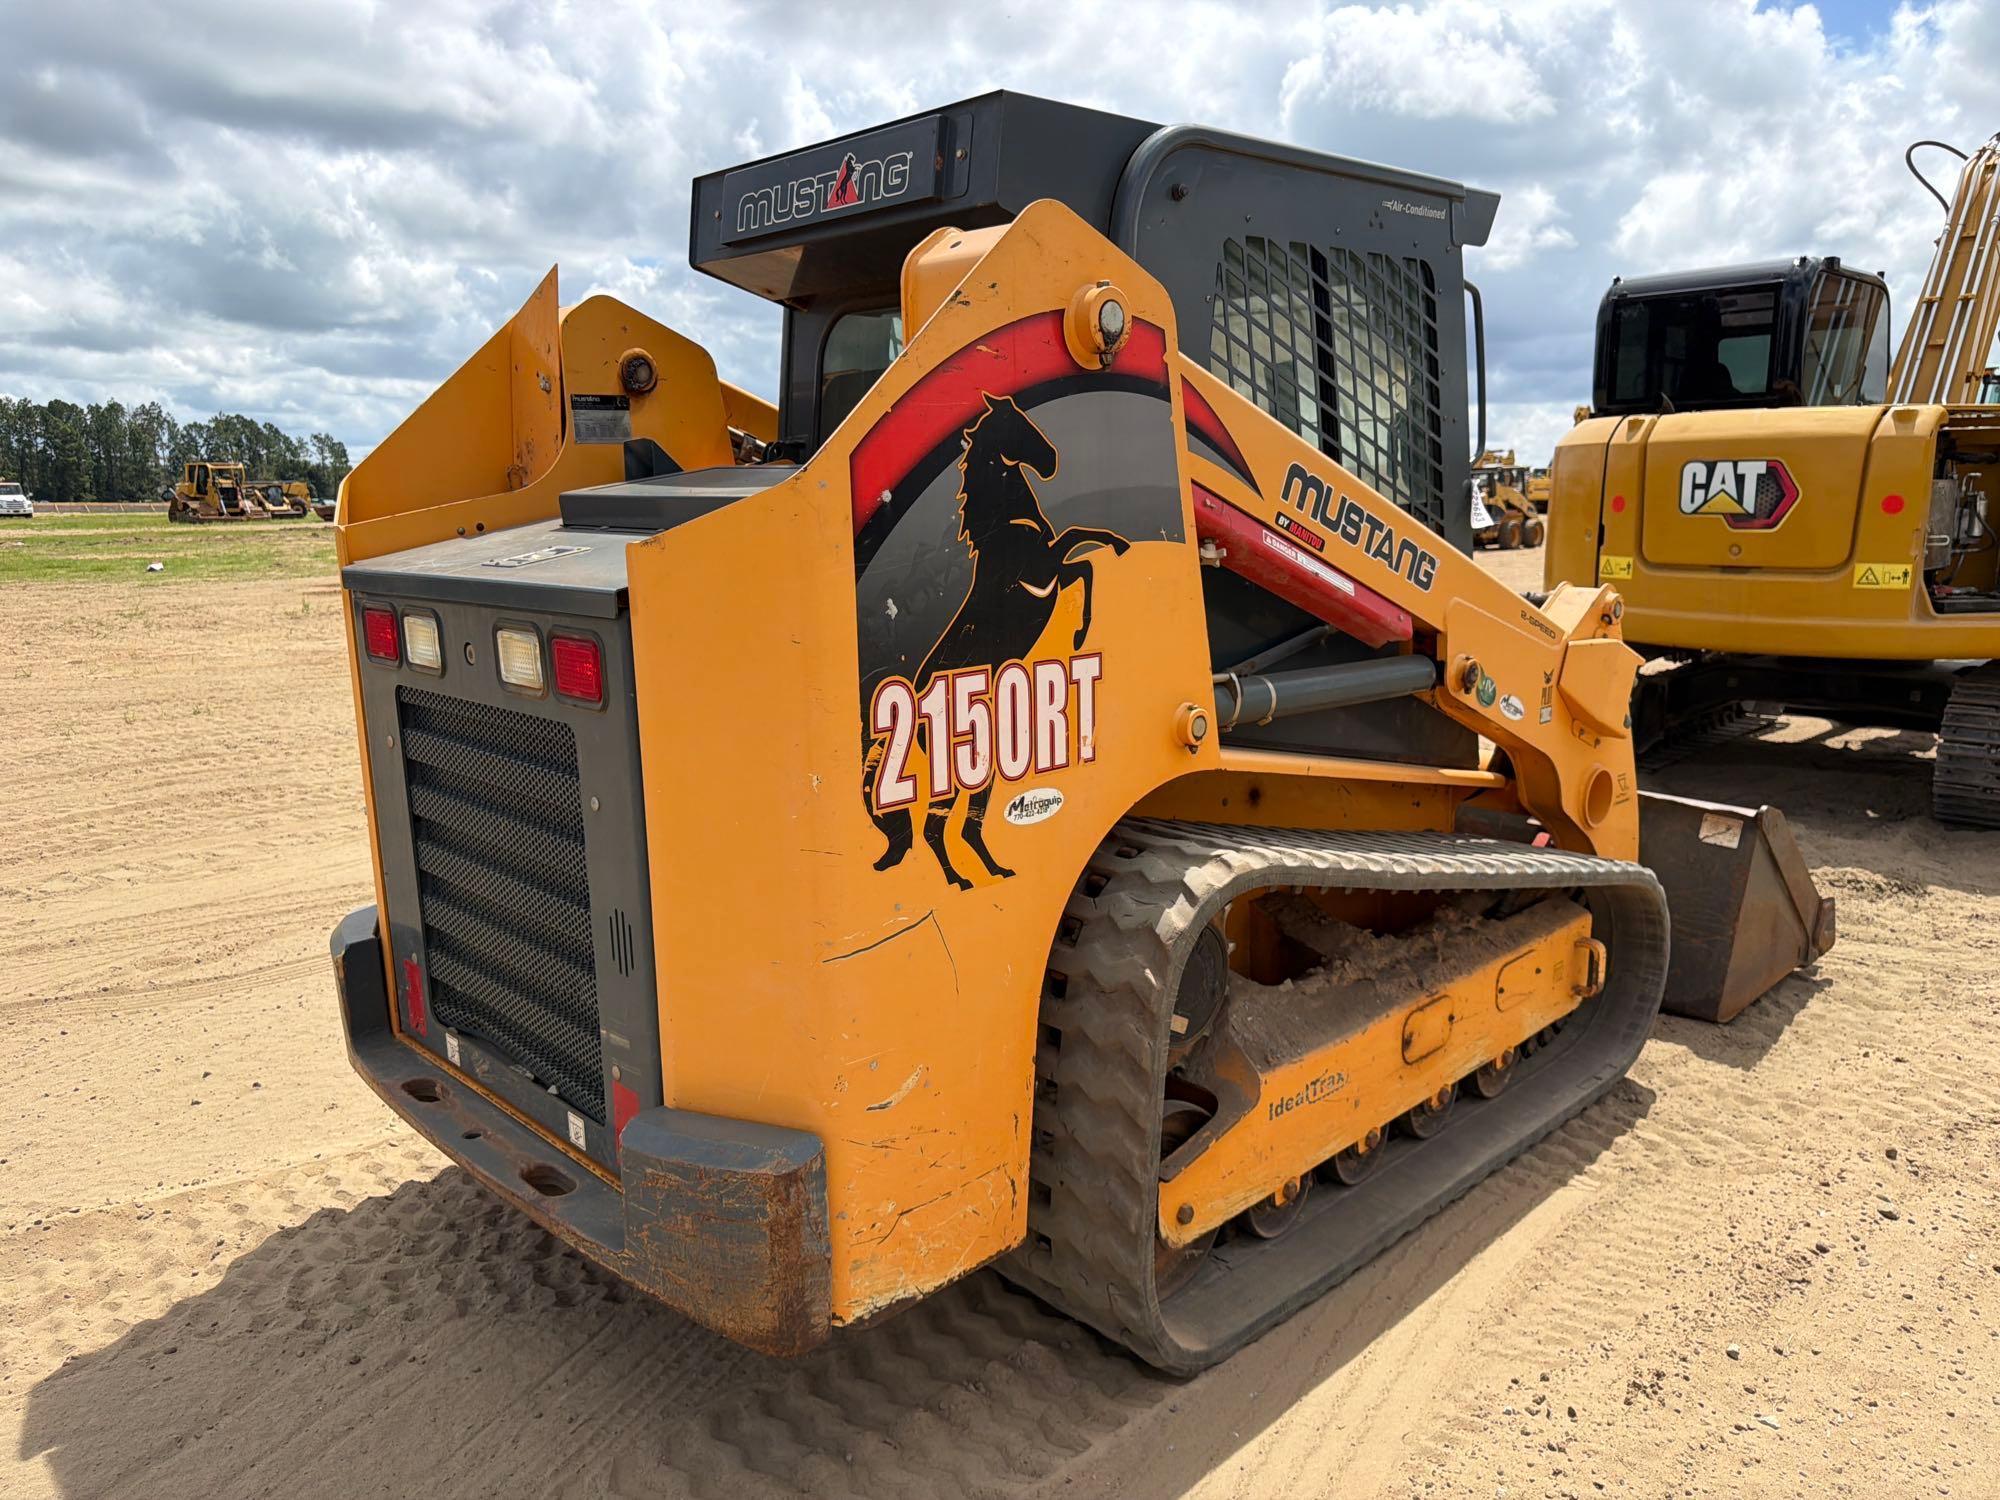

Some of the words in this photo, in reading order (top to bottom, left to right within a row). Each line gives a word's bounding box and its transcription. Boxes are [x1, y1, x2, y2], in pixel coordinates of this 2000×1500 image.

[737, 151, 910, 232] MUSTANG
[1392, 200, 1446, 219] Air-Conditioned
[1680, 460, 1767, 515] CAT
[1278, 515, 1290, 528] BY
[1289, 521, 1323, 549] MANITOU
[1280, 461, 1437, 592] MUSTANG
[1272, 539, 1297, 559] DANGER
[1520, 610, 1556, 639] 2-SPEED
[873, 652, 1103, 810] 2150RT
